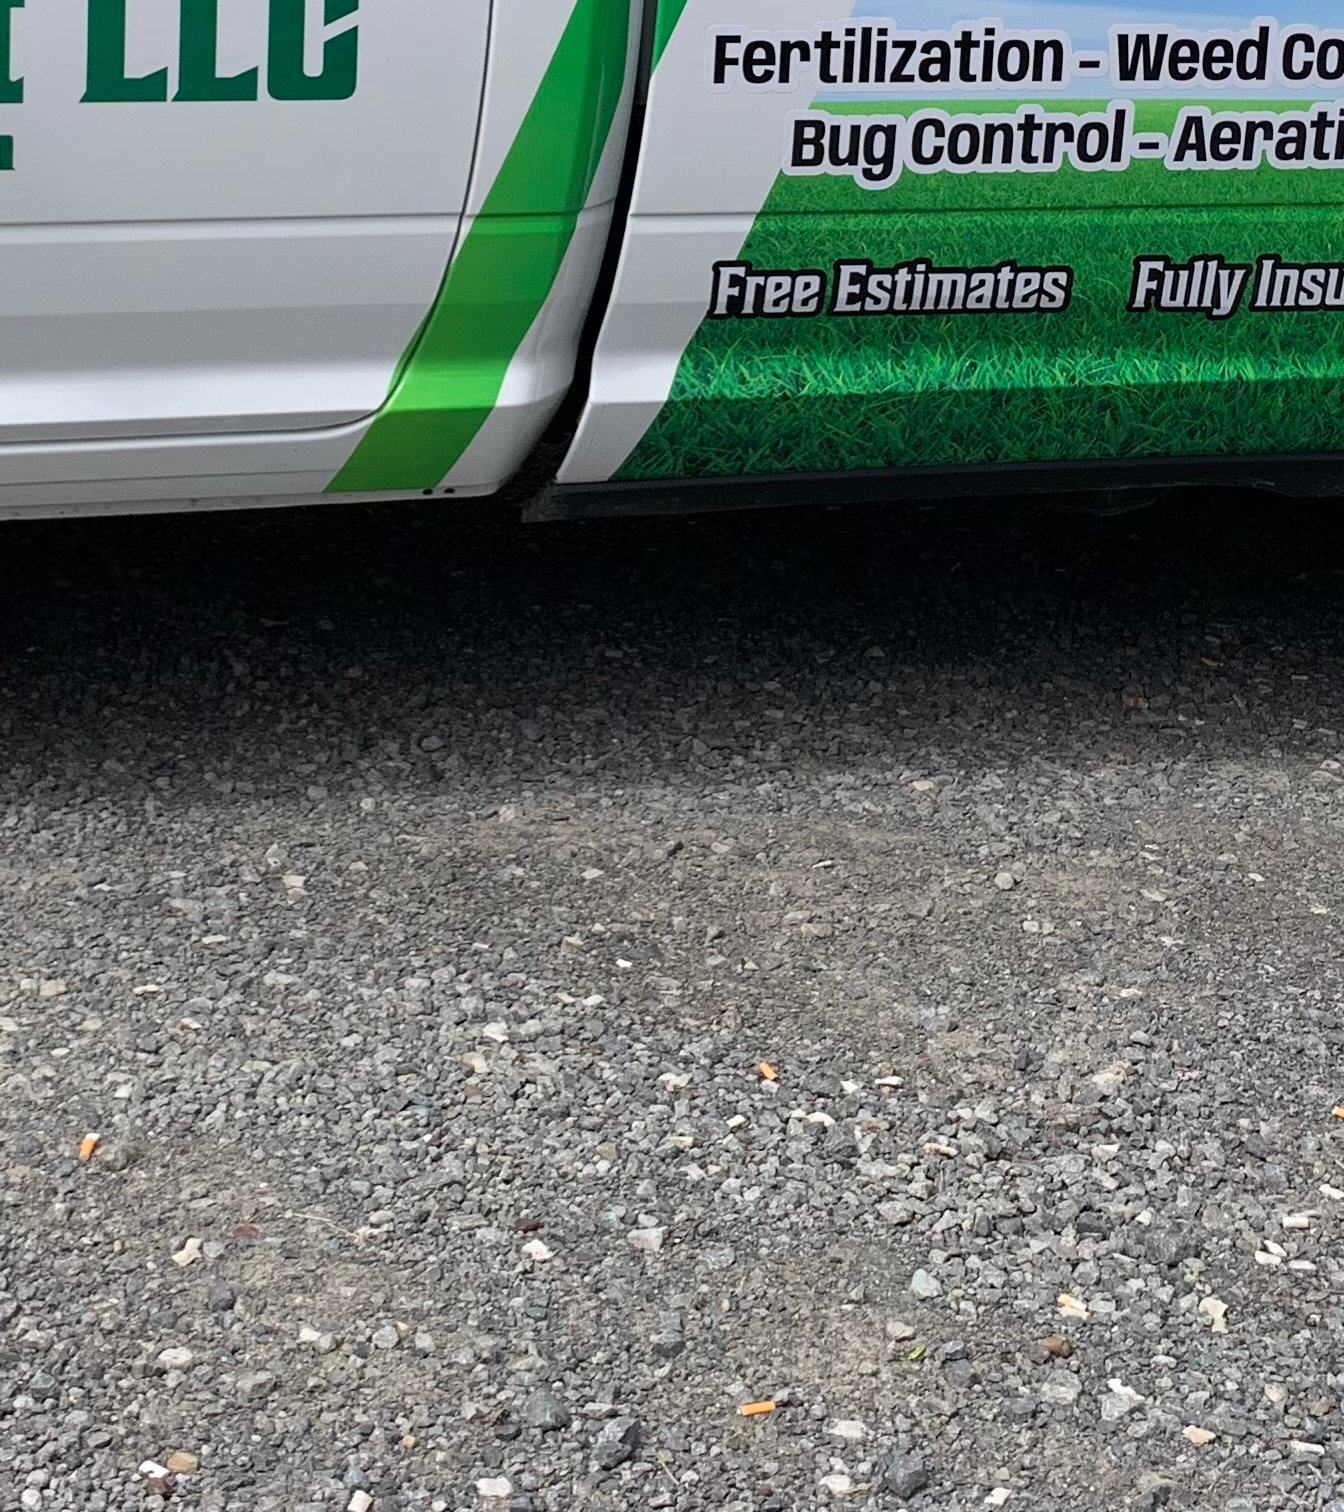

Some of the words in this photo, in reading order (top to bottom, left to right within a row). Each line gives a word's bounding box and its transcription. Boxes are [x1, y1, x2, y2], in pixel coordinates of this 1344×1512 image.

[713, 27, 1064, 84] Fertilization
[1117, 26, 1270, 82] Weed
[791, 119, 897, 181] Bug
[911, 108, 1126, 168] Control
[713, 266, 822, 316] Free
[832, 263, 1068, 313] Estimates
[1131, 259, 1248, 316] Fully
